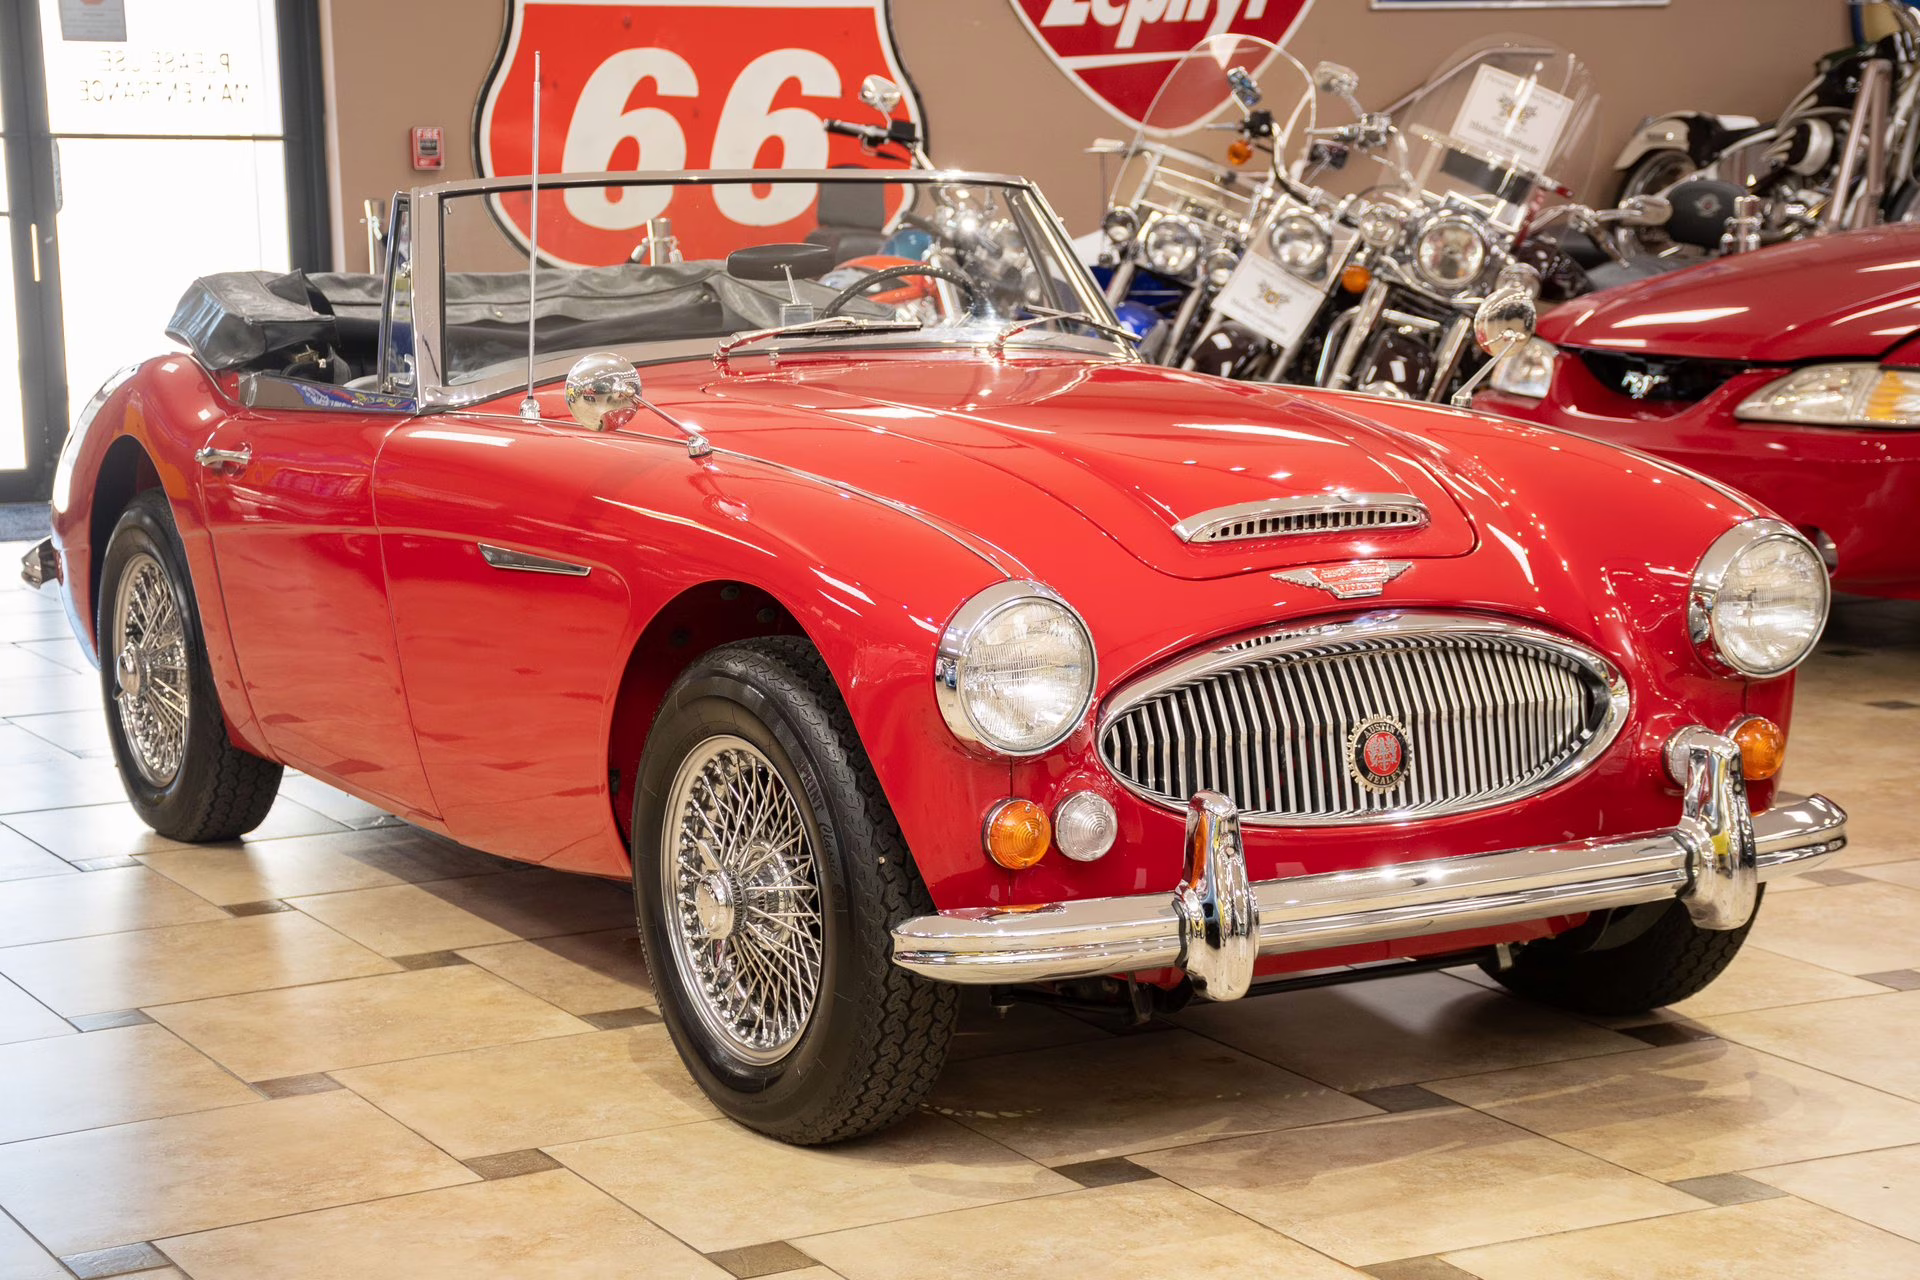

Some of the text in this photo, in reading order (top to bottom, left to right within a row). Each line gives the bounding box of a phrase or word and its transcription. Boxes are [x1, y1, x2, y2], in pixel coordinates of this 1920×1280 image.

[563, 47, 842, 230] 66
[1363, 723, 1396, 739] AUSTIN
[1366, 767, 1402, 784] HEALEY
